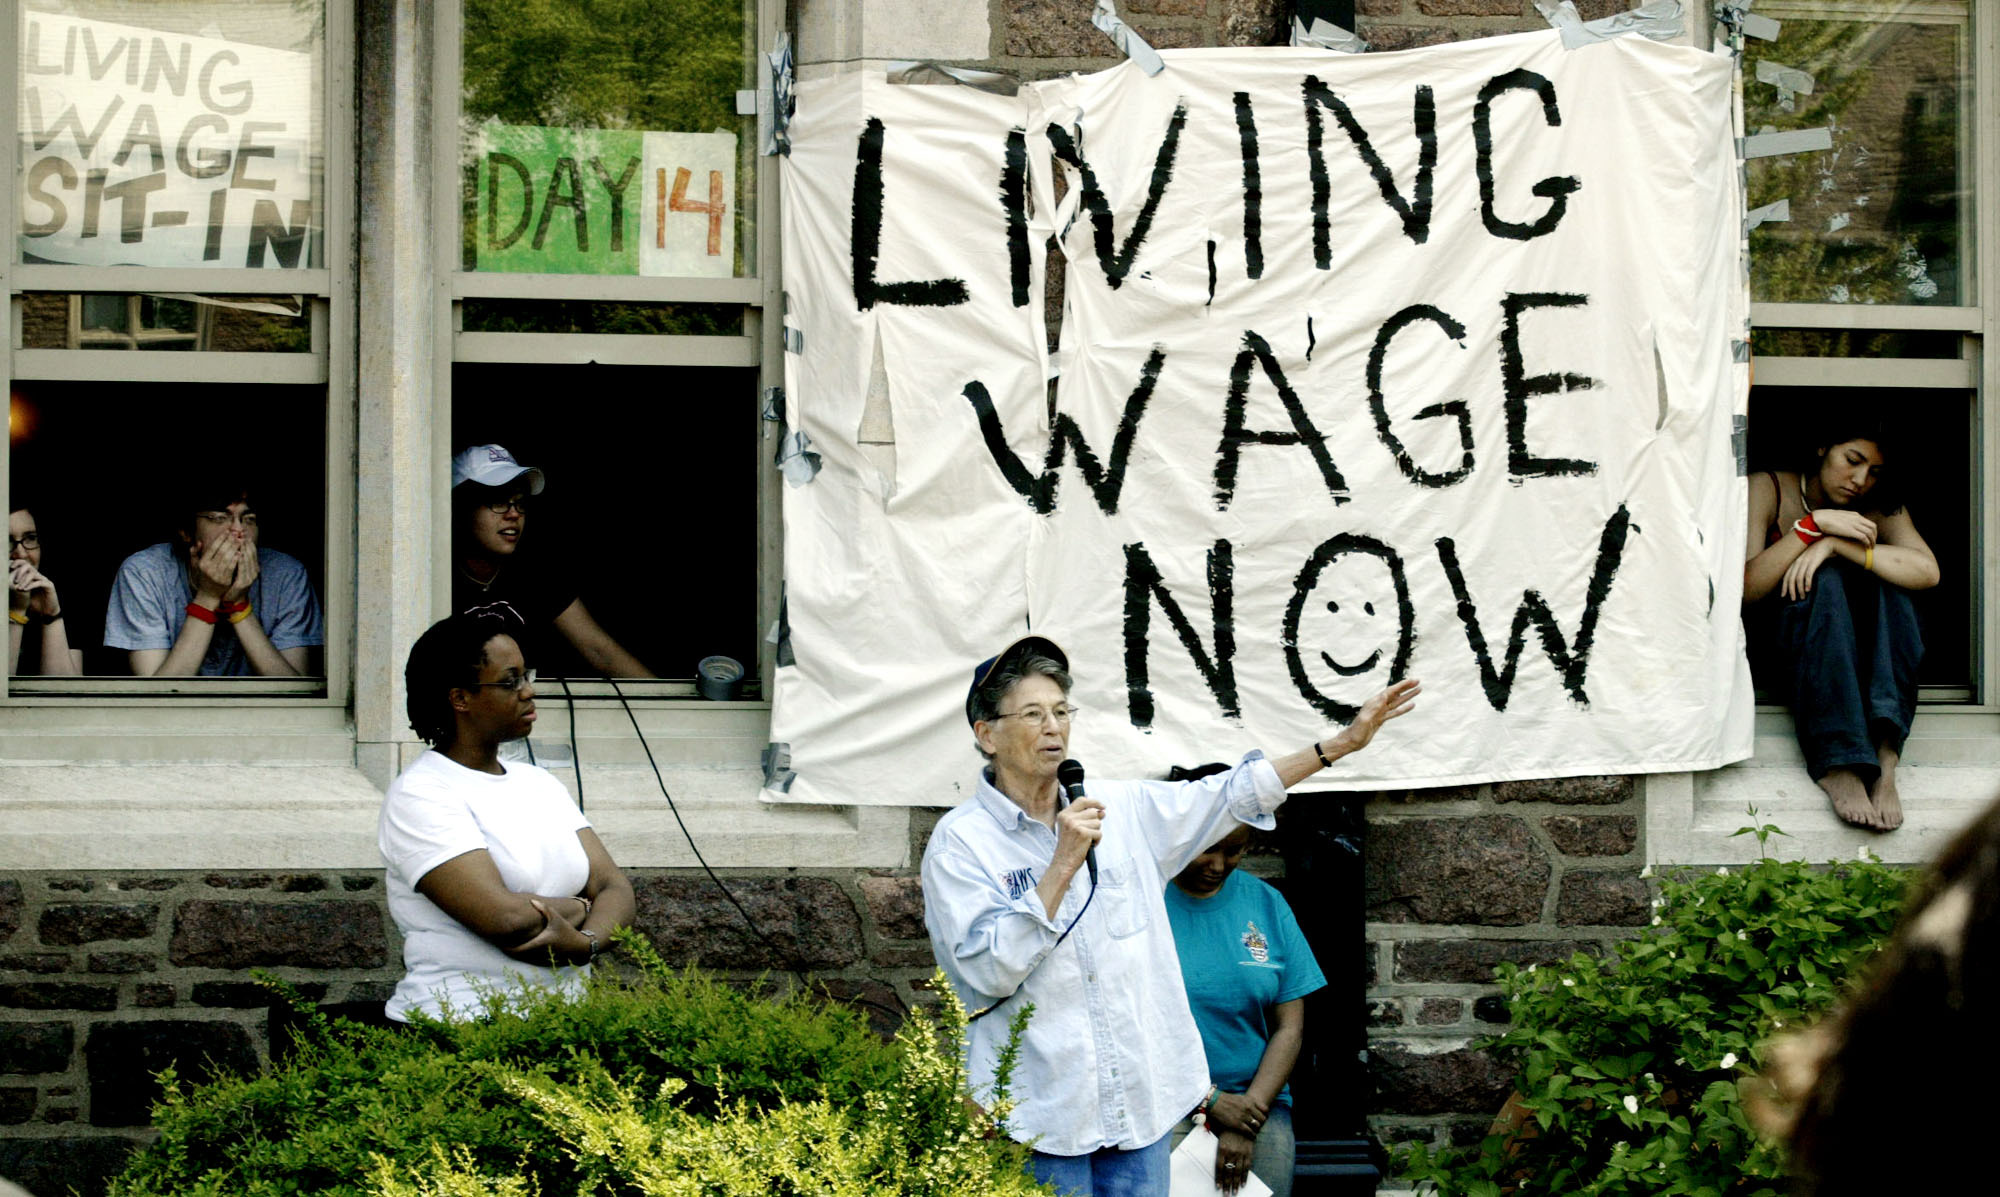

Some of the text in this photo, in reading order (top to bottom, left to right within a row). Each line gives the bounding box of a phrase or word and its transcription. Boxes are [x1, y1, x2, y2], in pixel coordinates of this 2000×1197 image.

[26, 21, 254, 115] LIVING
[26, 87, 287, 191] WAGE
[851, 68, 1581, 311] LIVING
[23, 156, 312, 268] SIT-IN
[488, 152, 725, 256] DAY 14
[962, 292, 1603, 516] WAGE
[1122, 503, 1640, 733] NOW
